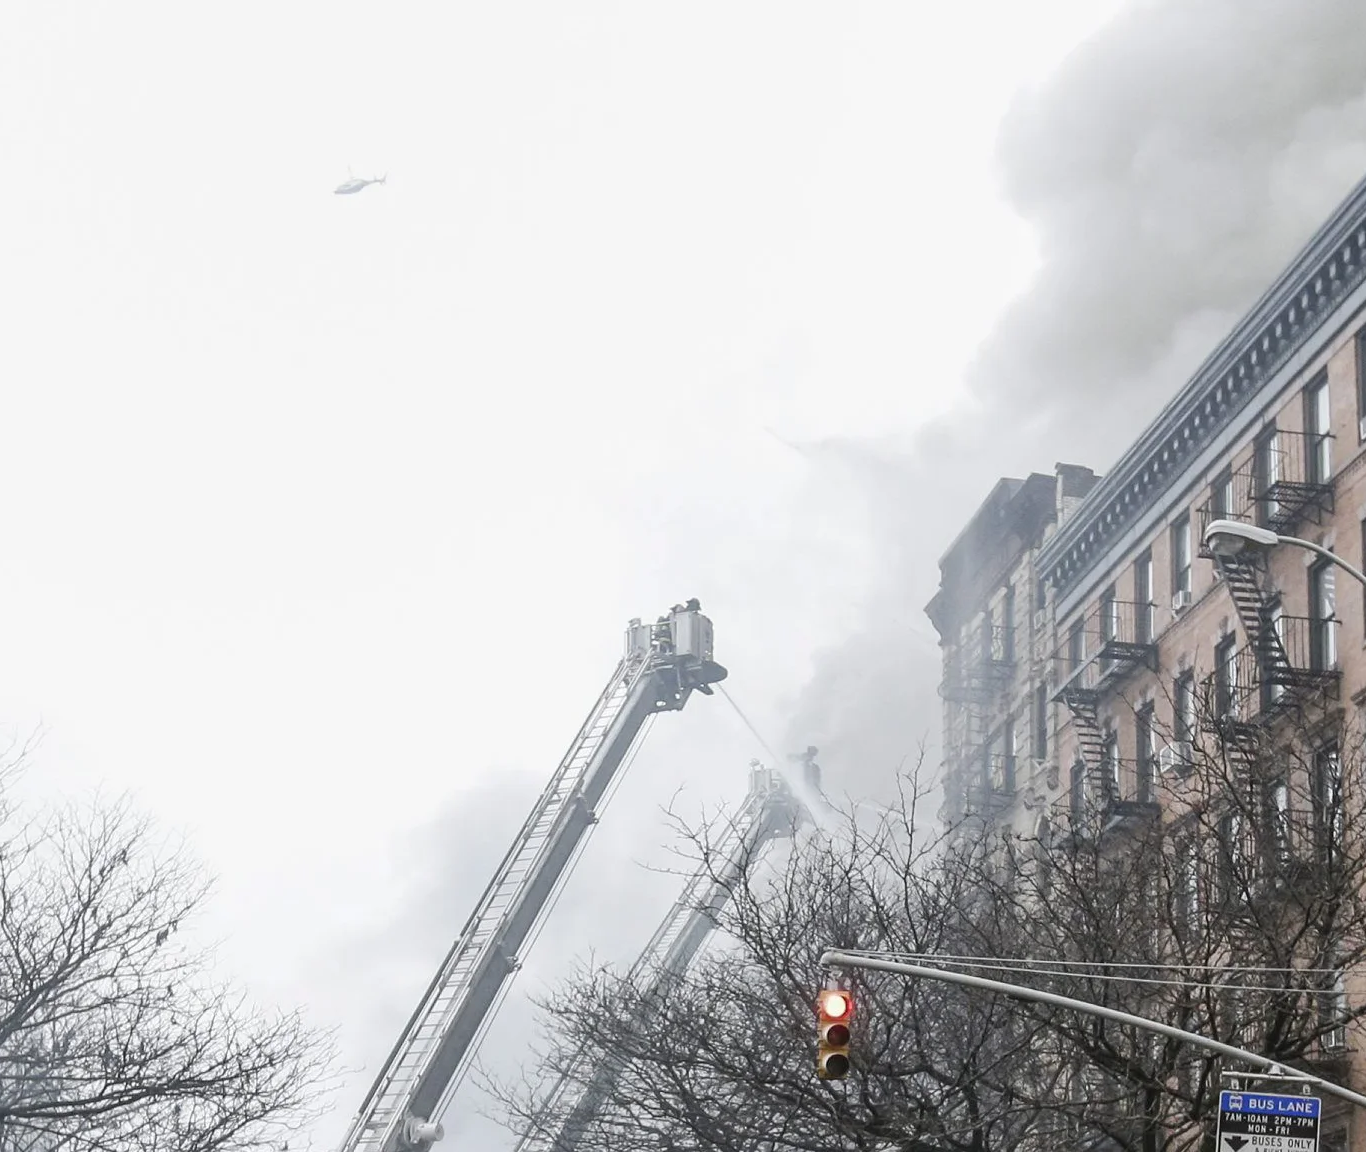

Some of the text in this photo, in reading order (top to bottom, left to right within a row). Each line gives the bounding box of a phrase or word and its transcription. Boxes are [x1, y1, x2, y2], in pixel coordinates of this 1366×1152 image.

[1248, 1098, 1313, 1114] BUS LANE
[1274, 1115, 1315, 1127] 2PM-7PM
[1248, 1125, 1266, 1134] MON
[1275, 1126, 1290, 1135] FRI
[1251, 1136, 1313, 1149] BUSES ONLY
